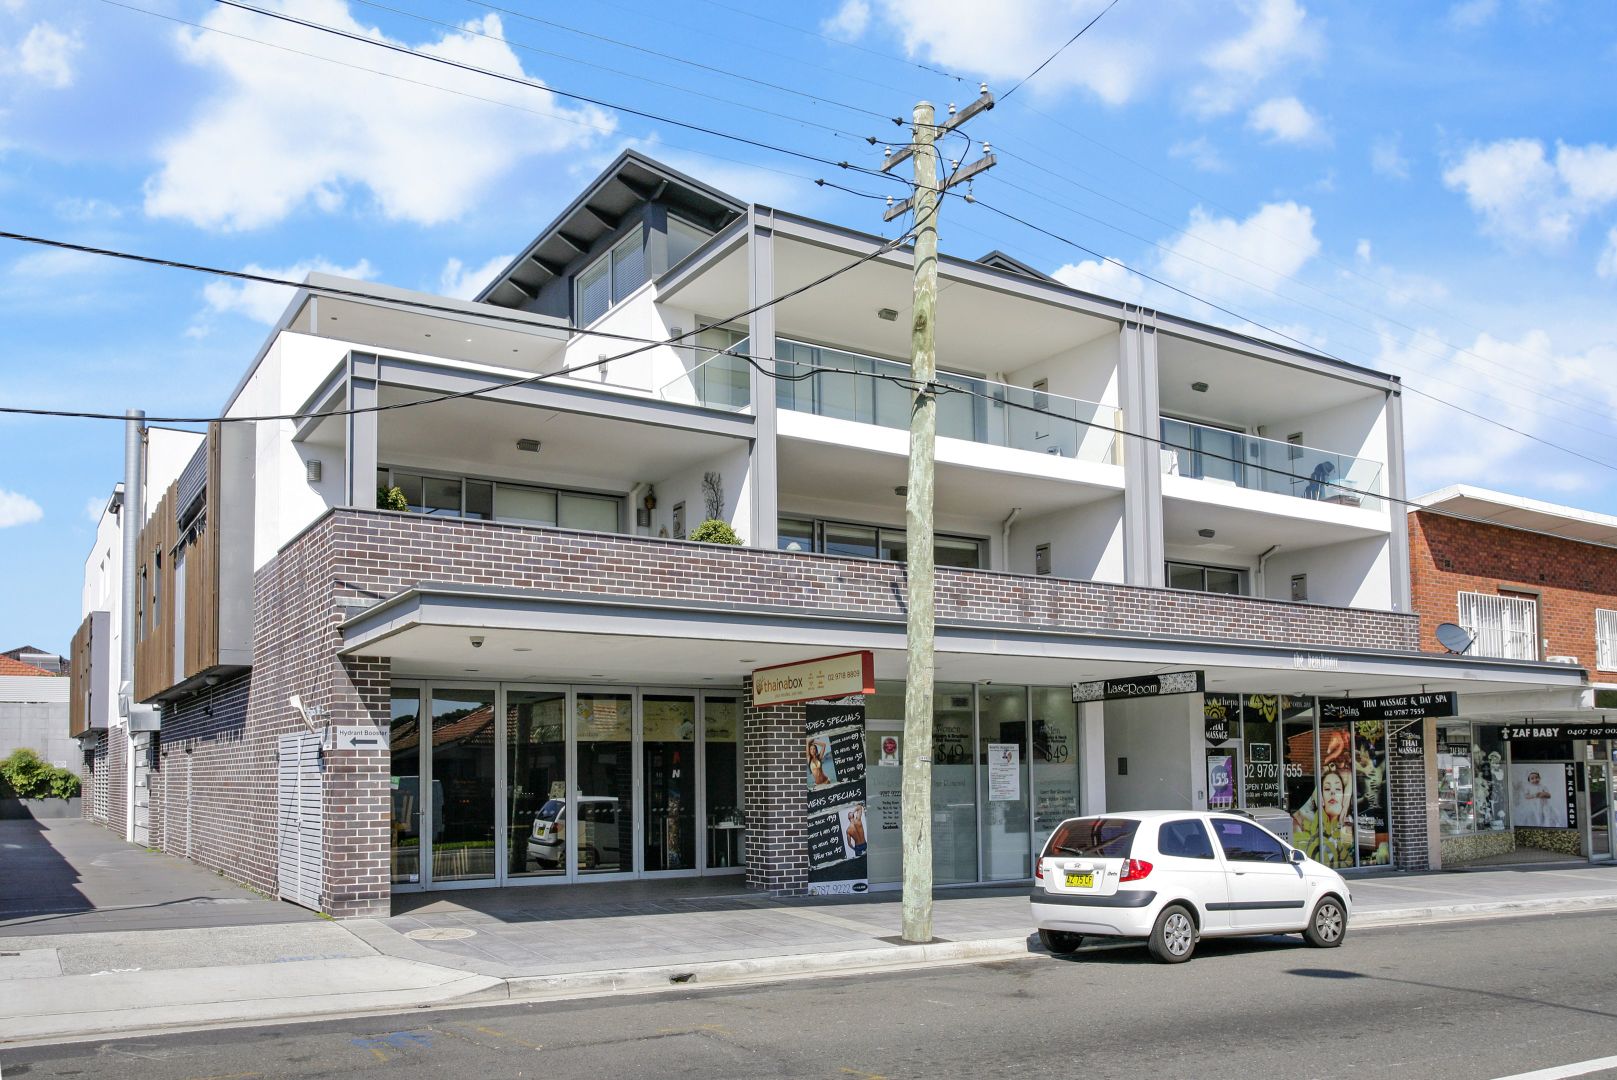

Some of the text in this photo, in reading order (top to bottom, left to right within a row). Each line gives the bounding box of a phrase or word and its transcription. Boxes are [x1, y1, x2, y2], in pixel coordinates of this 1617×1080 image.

[764, 675, 803, 693] thainabox
[1363, 694, 1448, 708] THAI MASSAGE & DAY SPA
[1384, 707, 1425, 717] 02 9787 7555
[826, 712, 861, 727] SPECIALS
[339, 729, 363, 737] Hydrant
[1205, 730, 1229, 740] MASSAGE
[1512, 728, 1531, 738] ZAF
[1533, 727, 1560, 738] BABY
[1567, 728, 1588, 736] 0407
[1589, 728, 1603, 736] 197
[1402, 739, 1418, 747] THAI
[1398, 746, 1423, 755] MASSAGE
[1244, 763, 1255, 778] 02
[1256, 763, 1279, 778] 9787
[1245, 783, 1260, 791] OPEN
[1265, 782, 1279, 790] DAYS
[827, 788, 862, 804] SPECIALS
[832, 883, 851, 894] 9222
